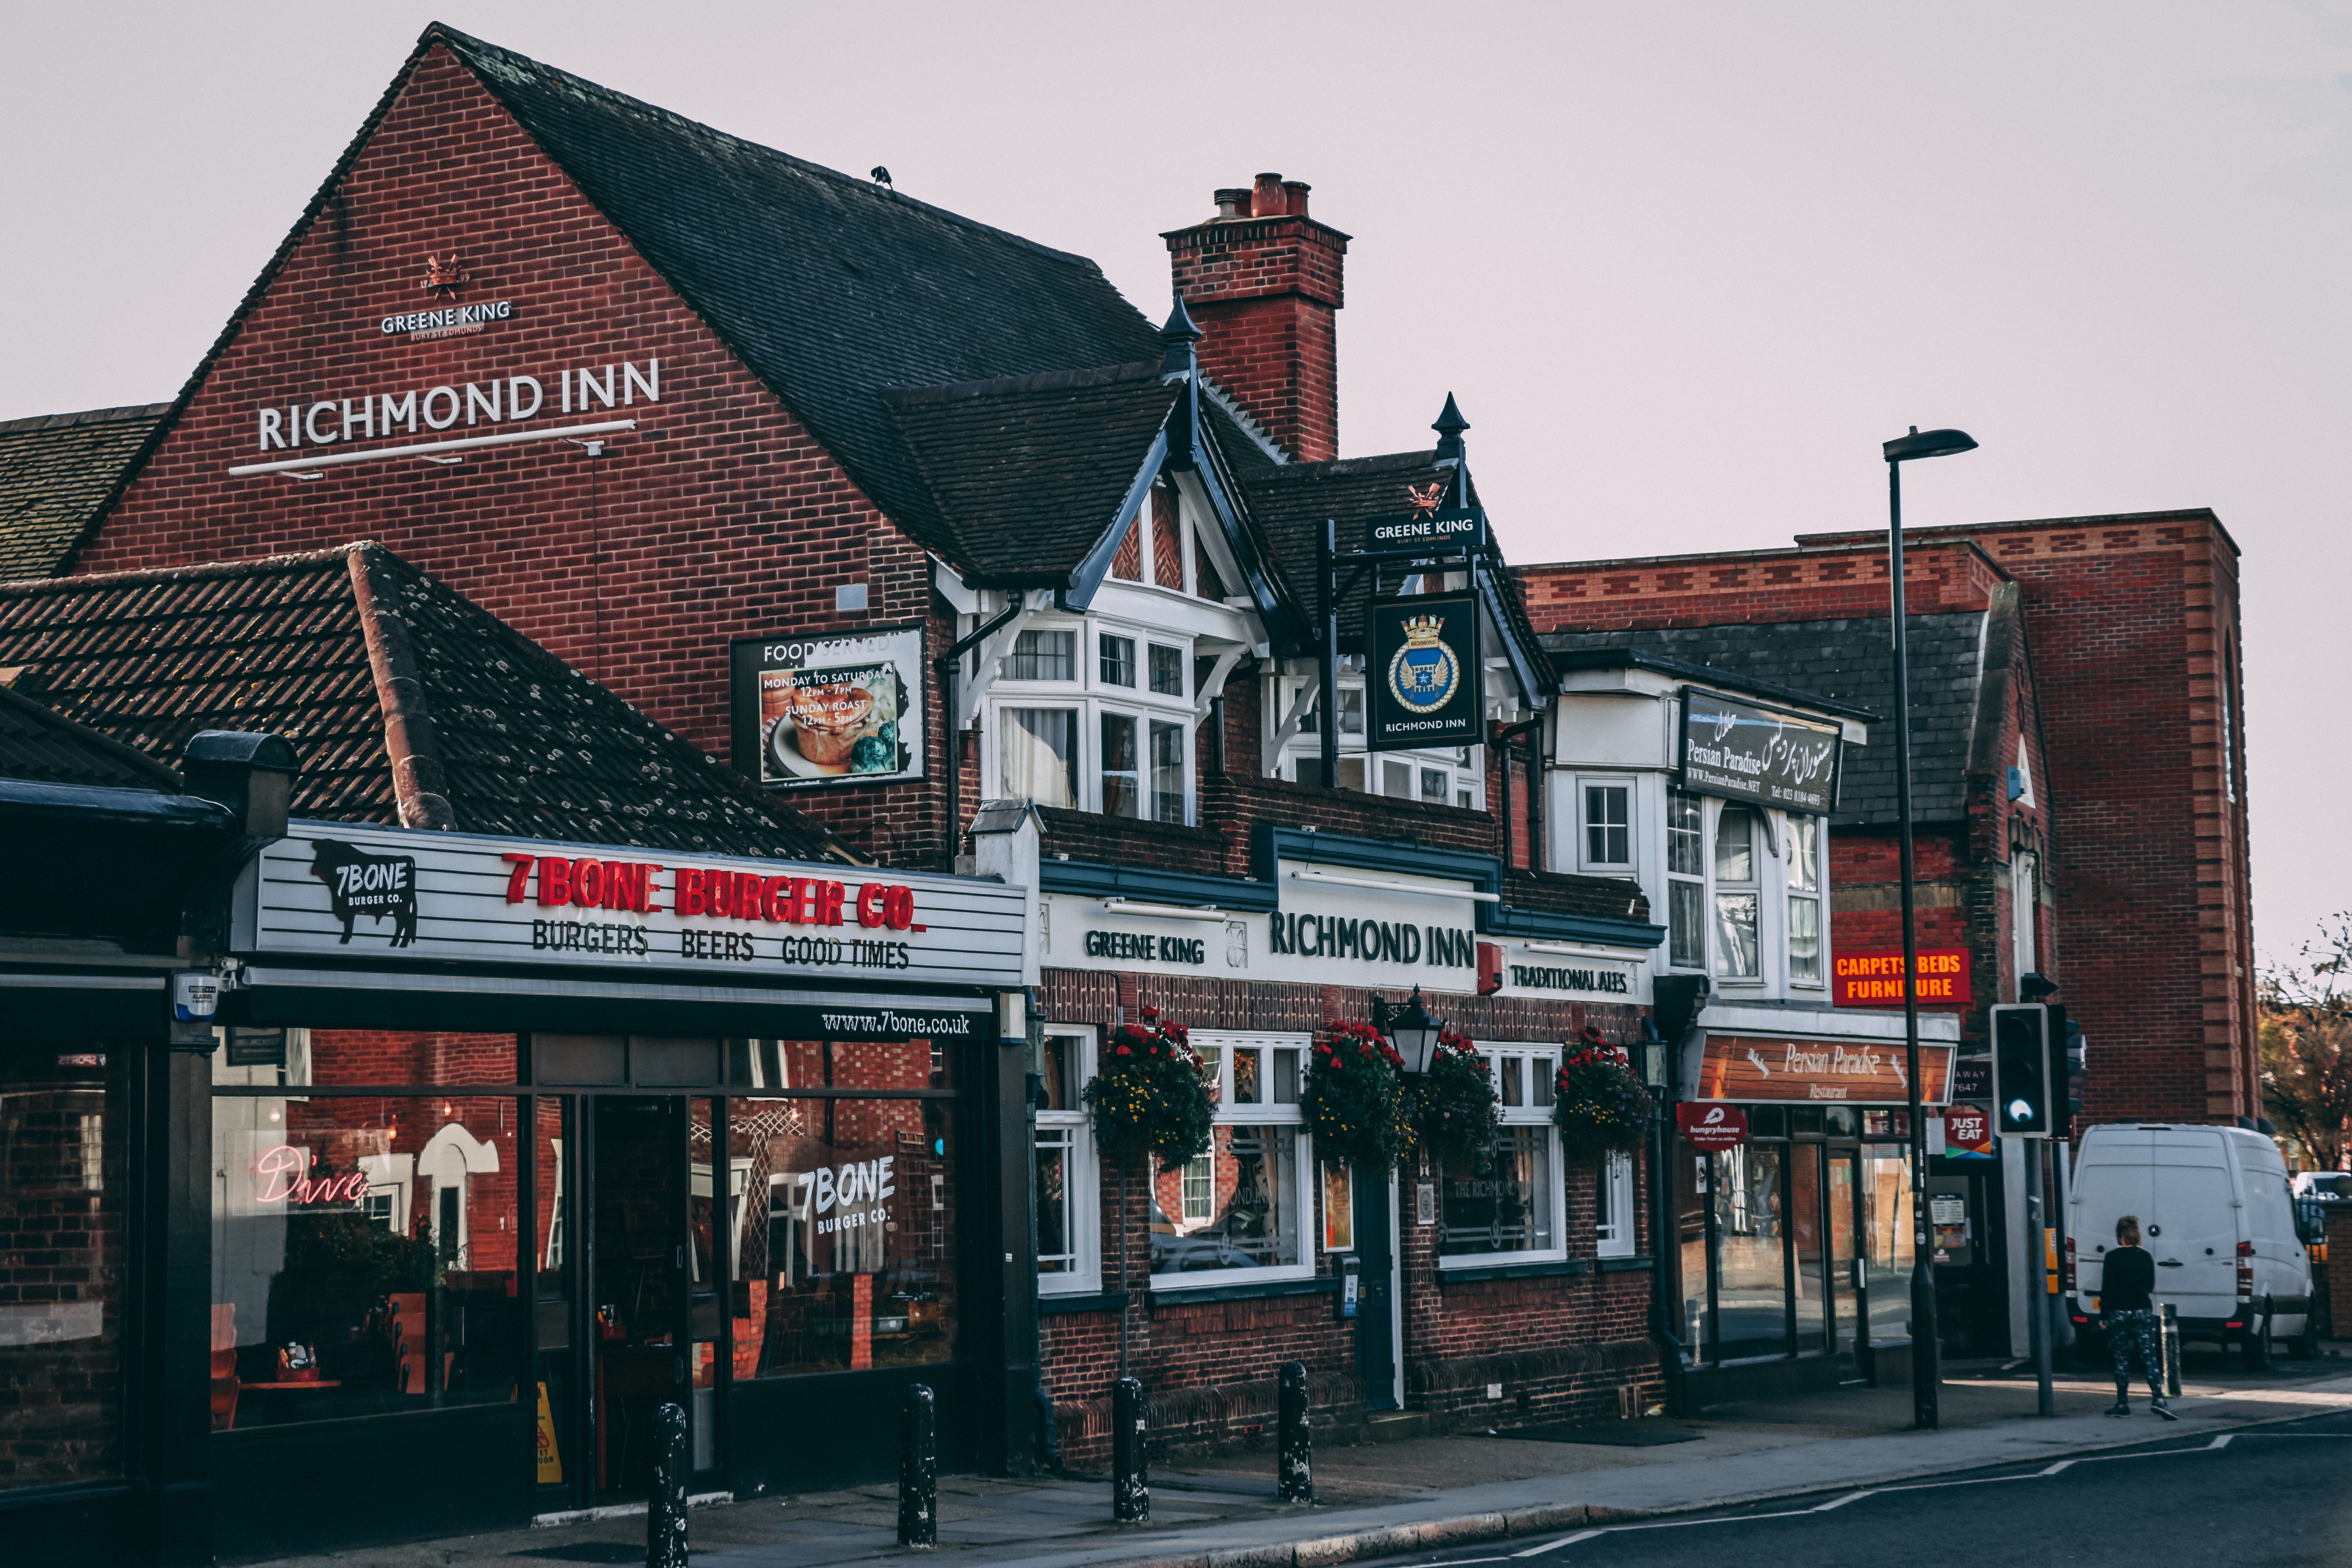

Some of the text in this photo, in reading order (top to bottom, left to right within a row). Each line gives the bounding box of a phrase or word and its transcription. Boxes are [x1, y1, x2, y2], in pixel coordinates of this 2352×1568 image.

[381, 301, 511, 334] GREENE KING
[411, 332, 430, 341] BURY
[445, 325, 482, 336] EDMUNDS
[260, 358, 659, 450] RICHMOND INN
[1375, 519, 1474, 539] GREENE KING
[764, 643, 816, 662] FOOD
[764, 675, 811, 689] MONDAY
[814, 674, 828, 684] TO
[801, 686, 824, 697] 12PM
[834, 684, 852, 695] 7PM
[786, 700, 866, 715] SUNDAY ROAST
[802, 715, 826, 725] 12PM
[834, 712, 853, 722] 5PM
[1386, 719, 1466, 732] RICHMOND INN
[1688, 739, 1761, 775] Persian Paradise
[1771, 786, 1782, 798] Tel:
[1784, 788, 1793, 800] 023
[336, 862, 407, 897] 7BONE
[349, 894, 403, 906] BURGER CO.
[674, 868, 845, 926] BURGER
[857, 882, 927, 933] CO.
[533, 919, 909, 970] BURGERS BEERS GOOD TIMES
[1085, 930, 1205, 964] GREENE KING
[1270, 912, 1475, 969] RICHMOND INN
[1510, 965, 1628, 994] TRADITIONAL ALES
[1847, 978, 1953, 999] FURNIURE
[822, 1011, 969, 1034] www.7bone.co.uk
[1784, 1043, 1829, 1073] Persian
[1832, 1045, 1880, 1075] Paradise
[1809, 1083, 1847, 1099] Restaurant
[1690, 1125, 1740, 1134] hungryhouse
[1951, 1118, 1983, 1130] JUST
[1958, 1129, 1984, 1140] EAT
[798, 1155, 895, 1222] 7BONE
[1455, 1180, 1516, 1198] THE RICHMOND
[818, 1207, 891, 1234] BURGER CO.
